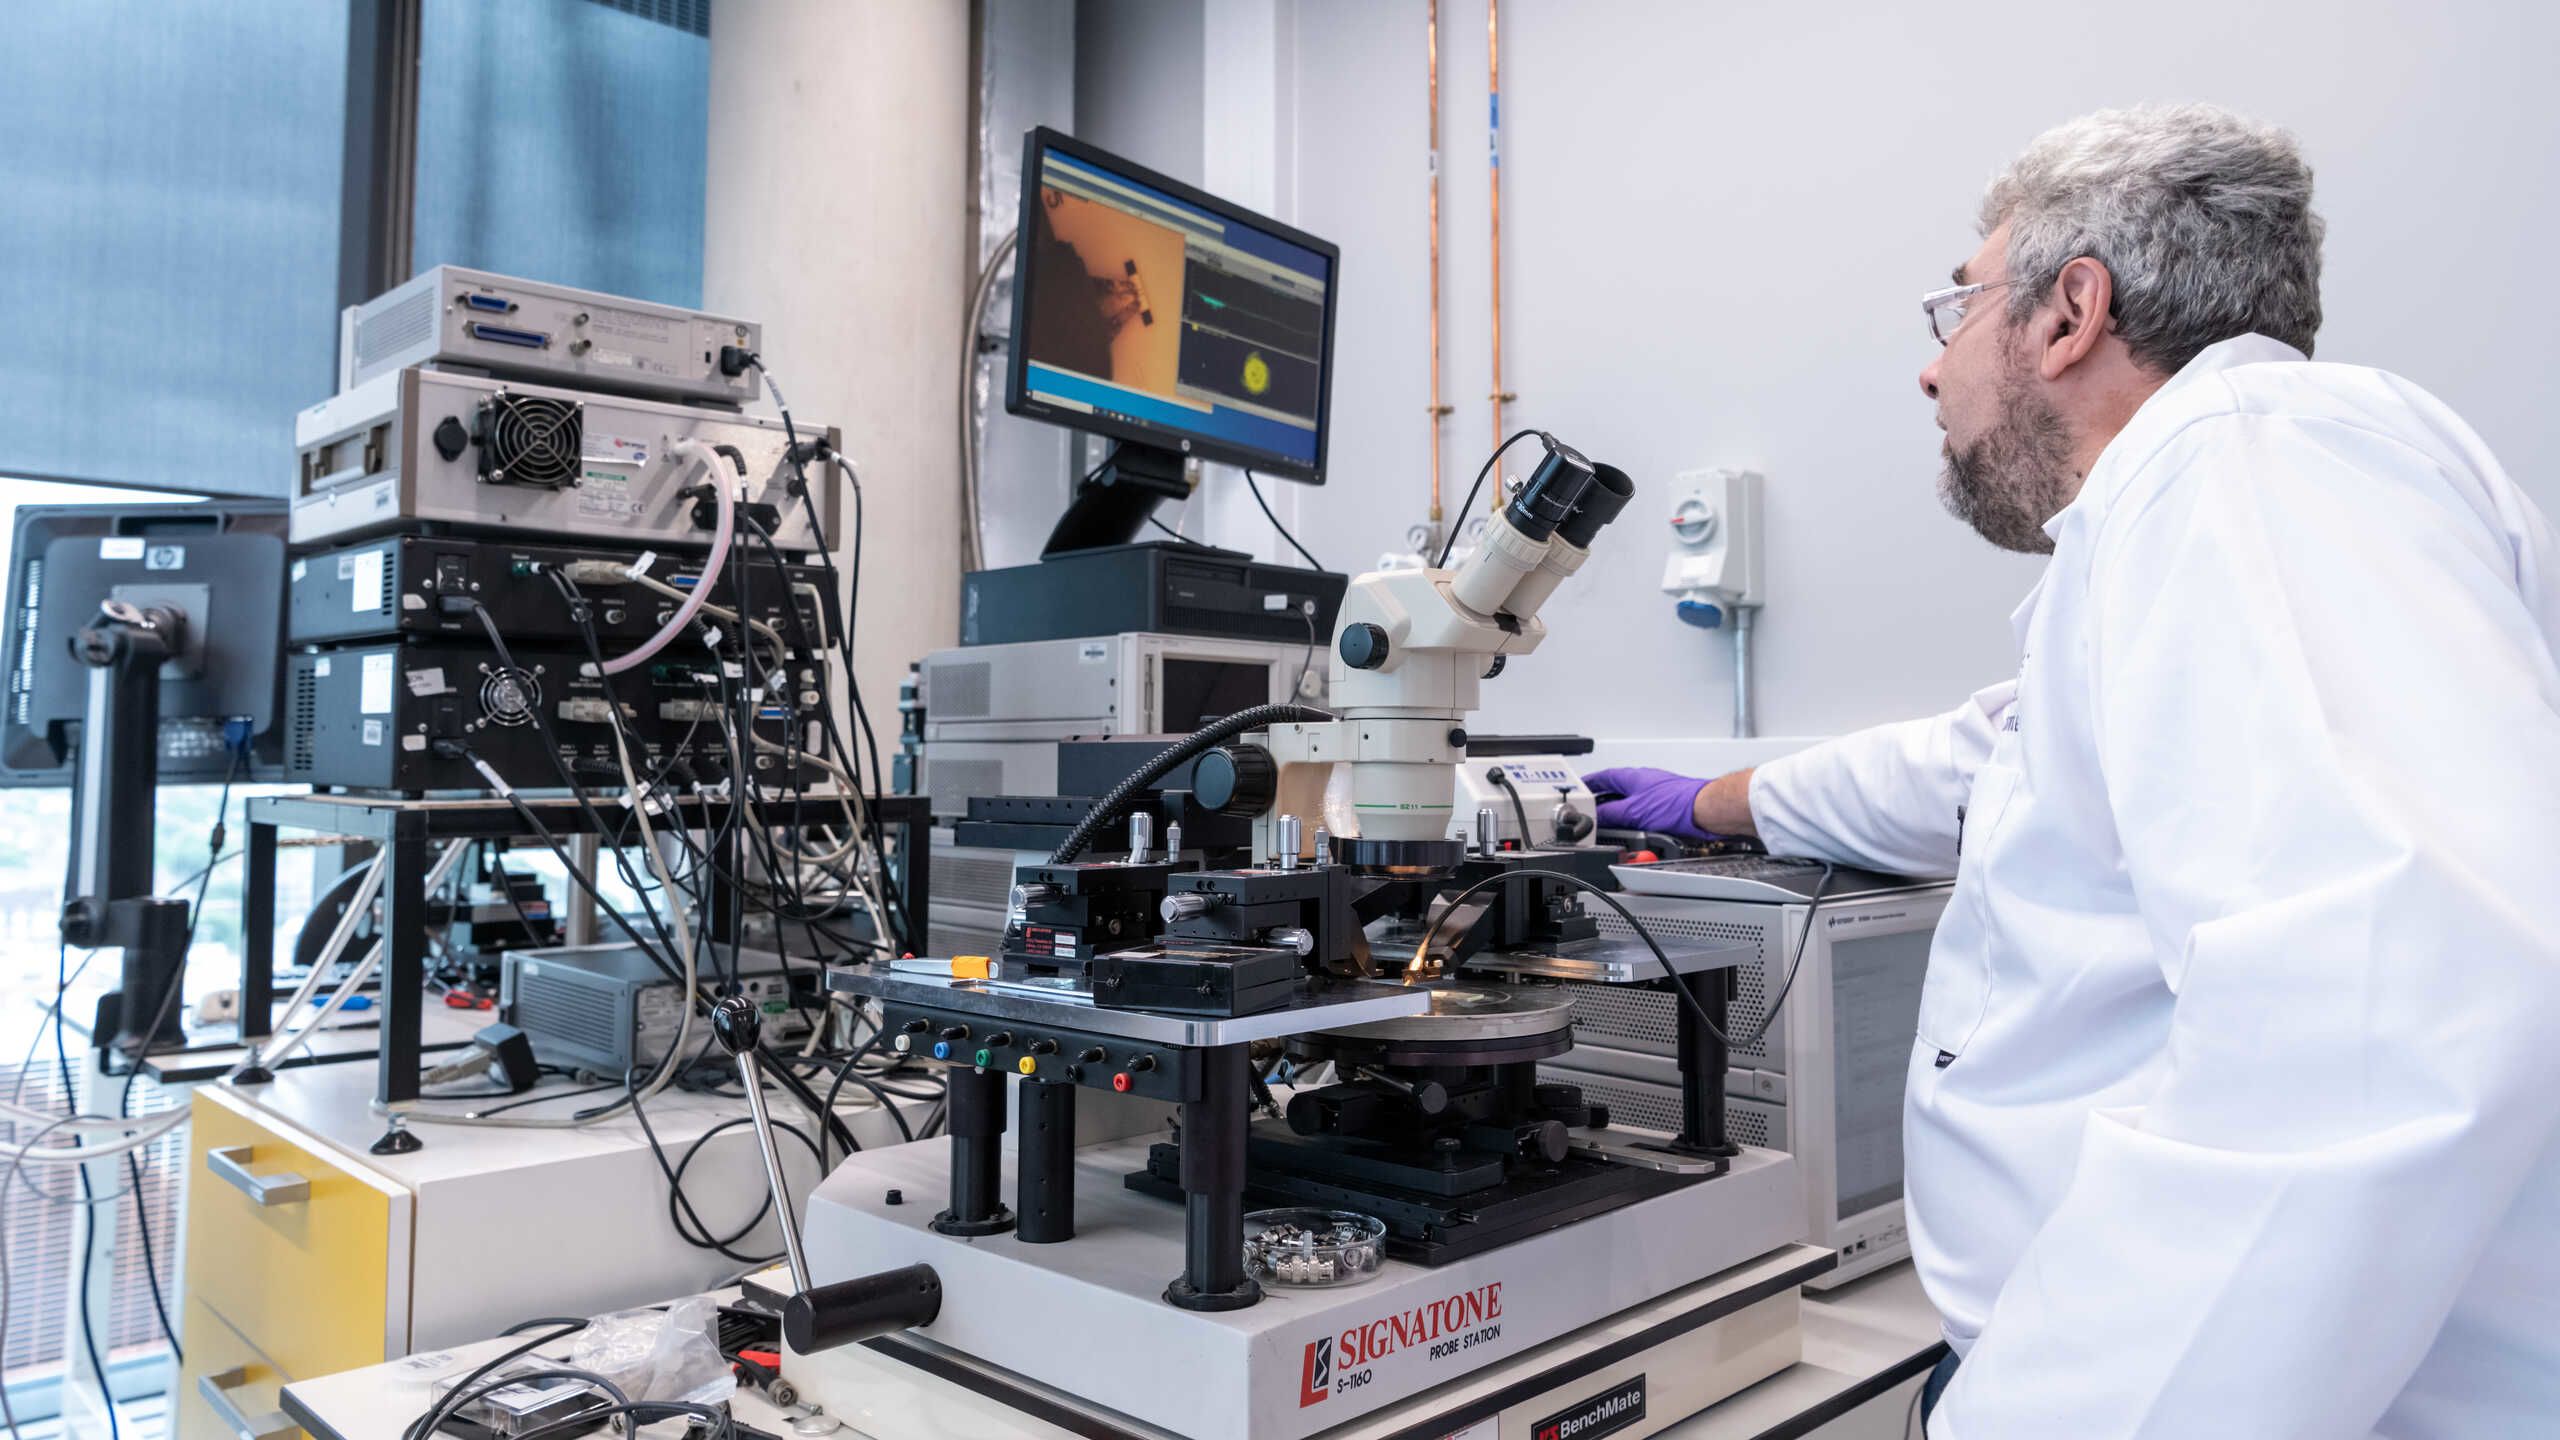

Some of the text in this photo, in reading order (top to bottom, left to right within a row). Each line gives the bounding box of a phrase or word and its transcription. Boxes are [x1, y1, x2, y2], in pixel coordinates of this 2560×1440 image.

[1337, 1281, 1503, 1372] SIGNATONE
[1429, 1323, 1502, 1362] PROBE STATION
[1336, 1368, 1373, 1395] S-1160
[1560, 1390, 1641, 1439] BenchMate
